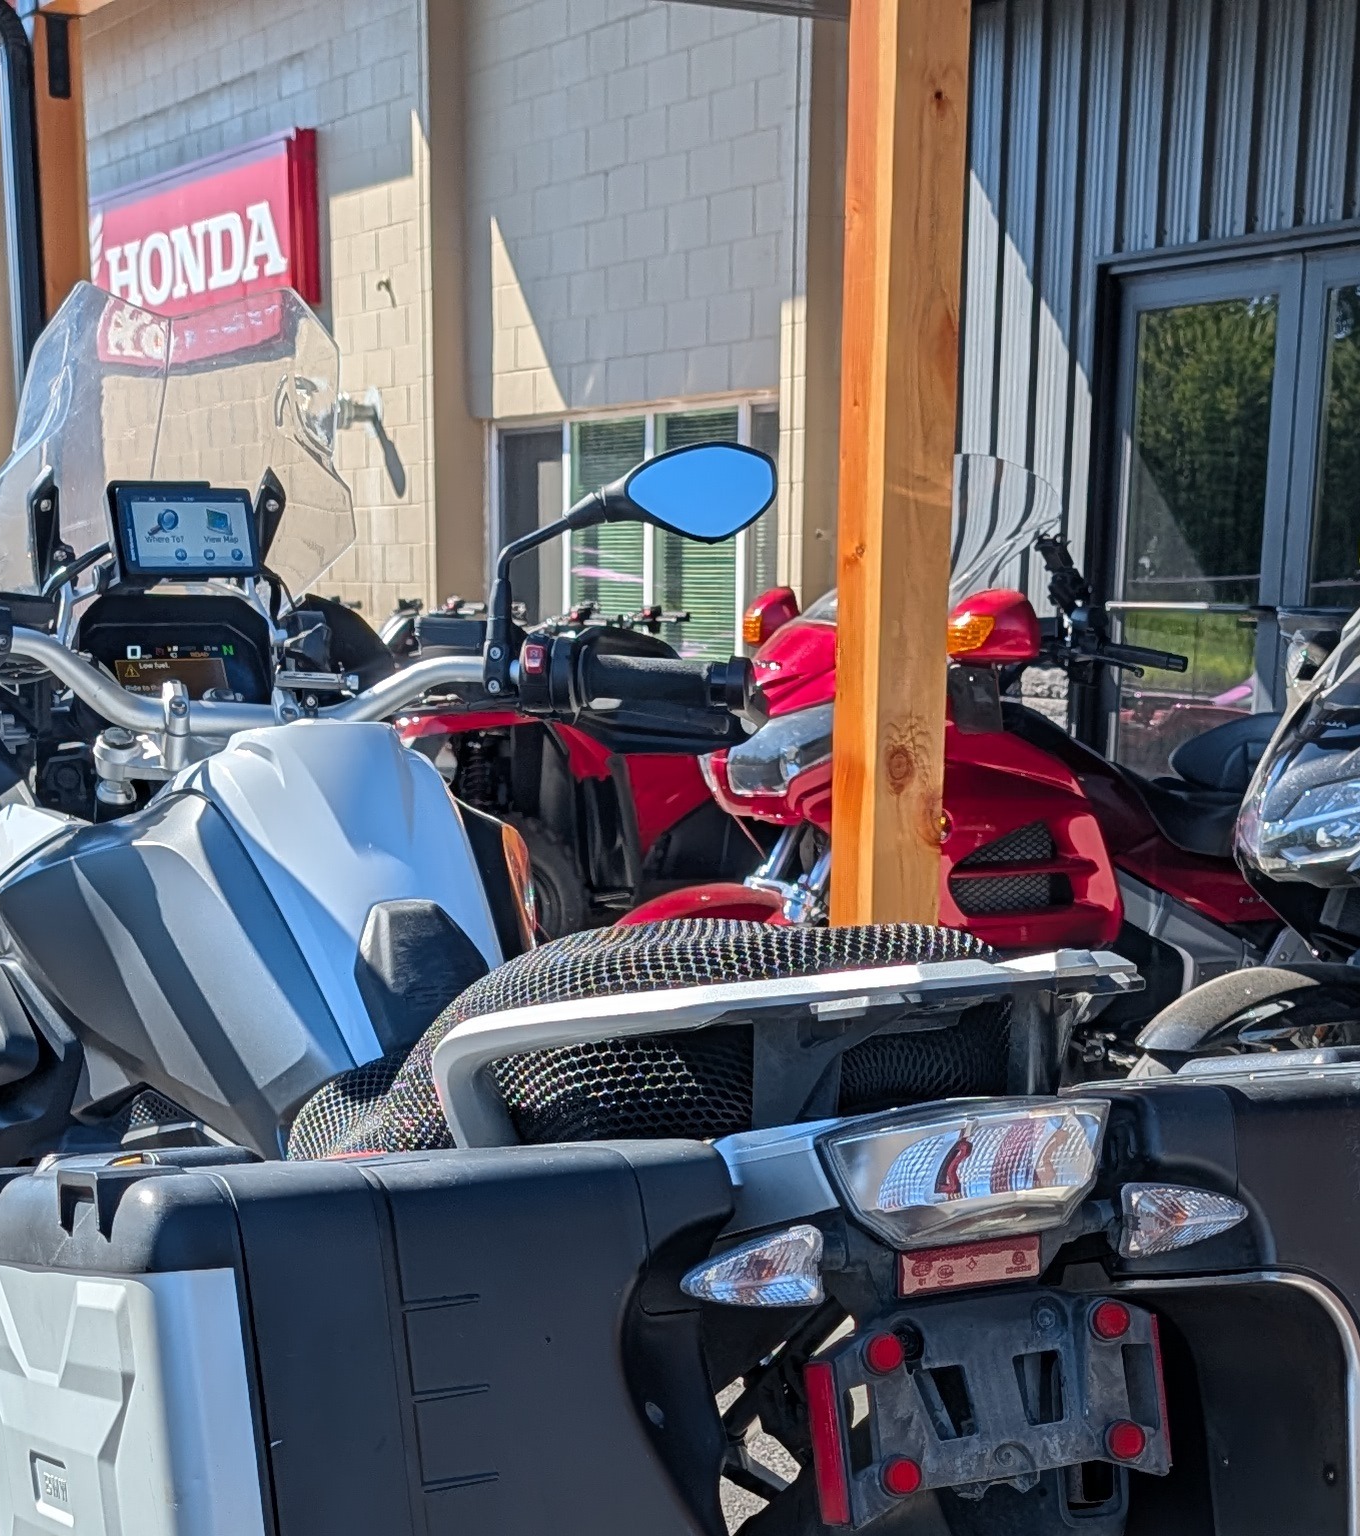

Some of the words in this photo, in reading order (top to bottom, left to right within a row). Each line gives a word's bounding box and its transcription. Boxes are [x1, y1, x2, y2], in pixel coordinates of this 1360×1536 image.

[104, 199, 288, 308] HONDA
[145, 535, 170, 543] Where
[203, 535, 222, 543] View
[224, 535, 239, 544] Map
[221, 644, 234, 656] N
[139, 662, 153, 670] Low
